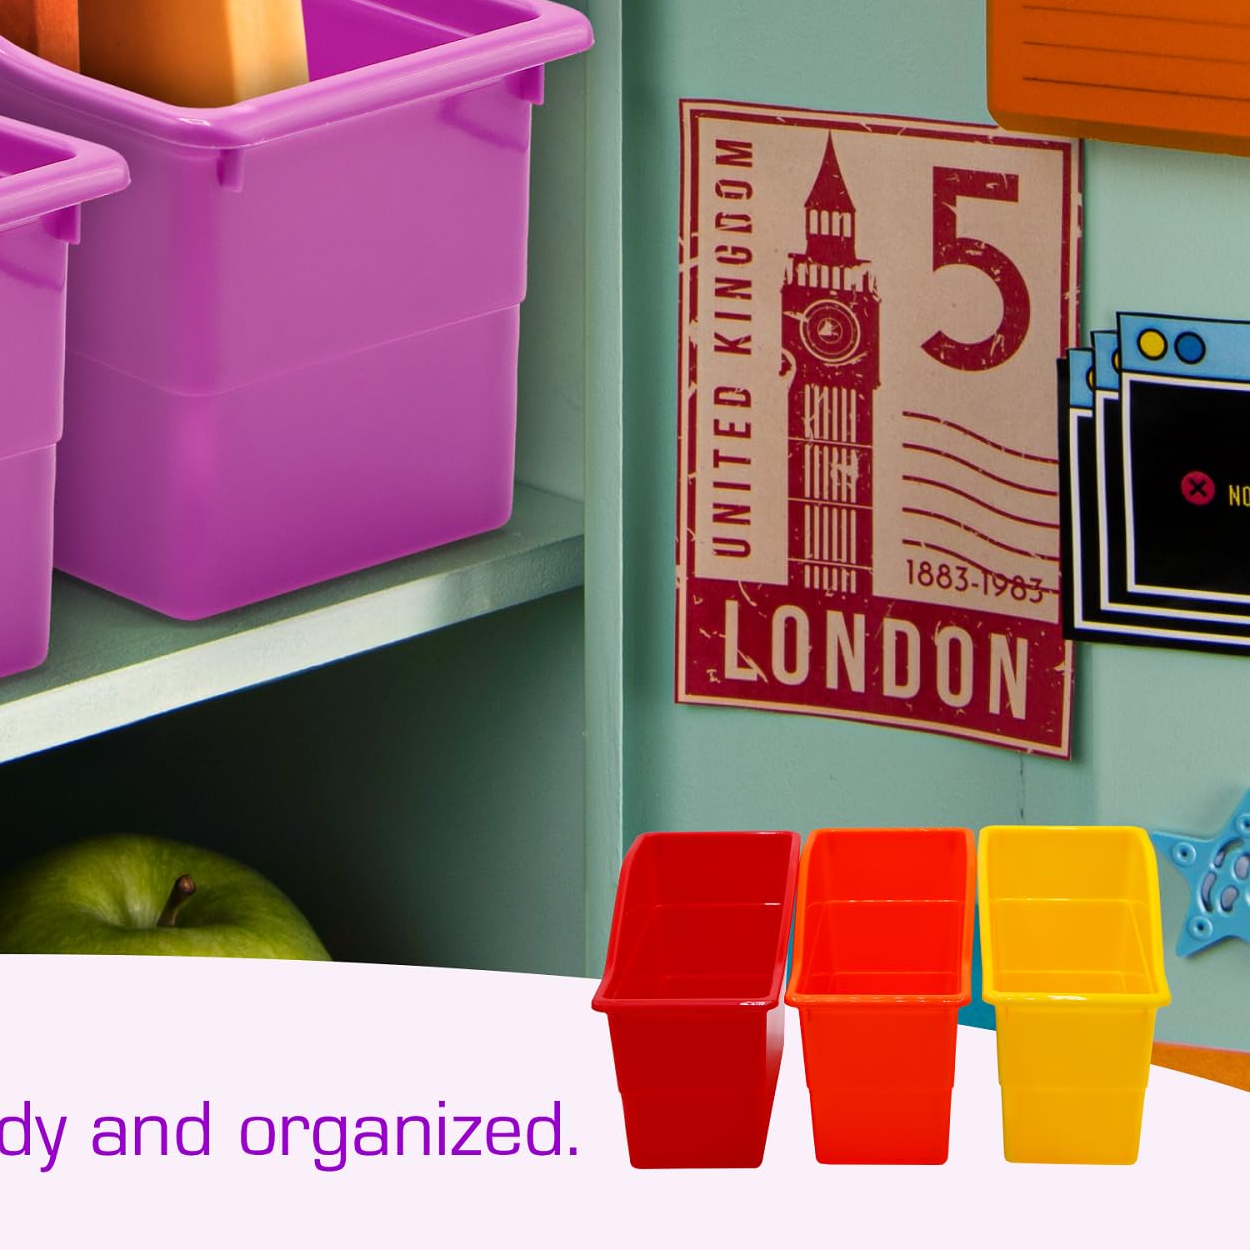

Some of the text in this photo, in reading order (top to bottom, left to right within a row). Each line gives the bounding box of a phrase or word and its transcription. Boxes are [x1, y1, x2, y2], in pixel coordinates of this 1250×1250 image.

[713, 139, 753, 558] UNITED KINGDOM
[920, 166, 1031, 372] 5
[725, 599, 1028, 720] LONDON
[907, 559, 1043, 603] 1883-1983
